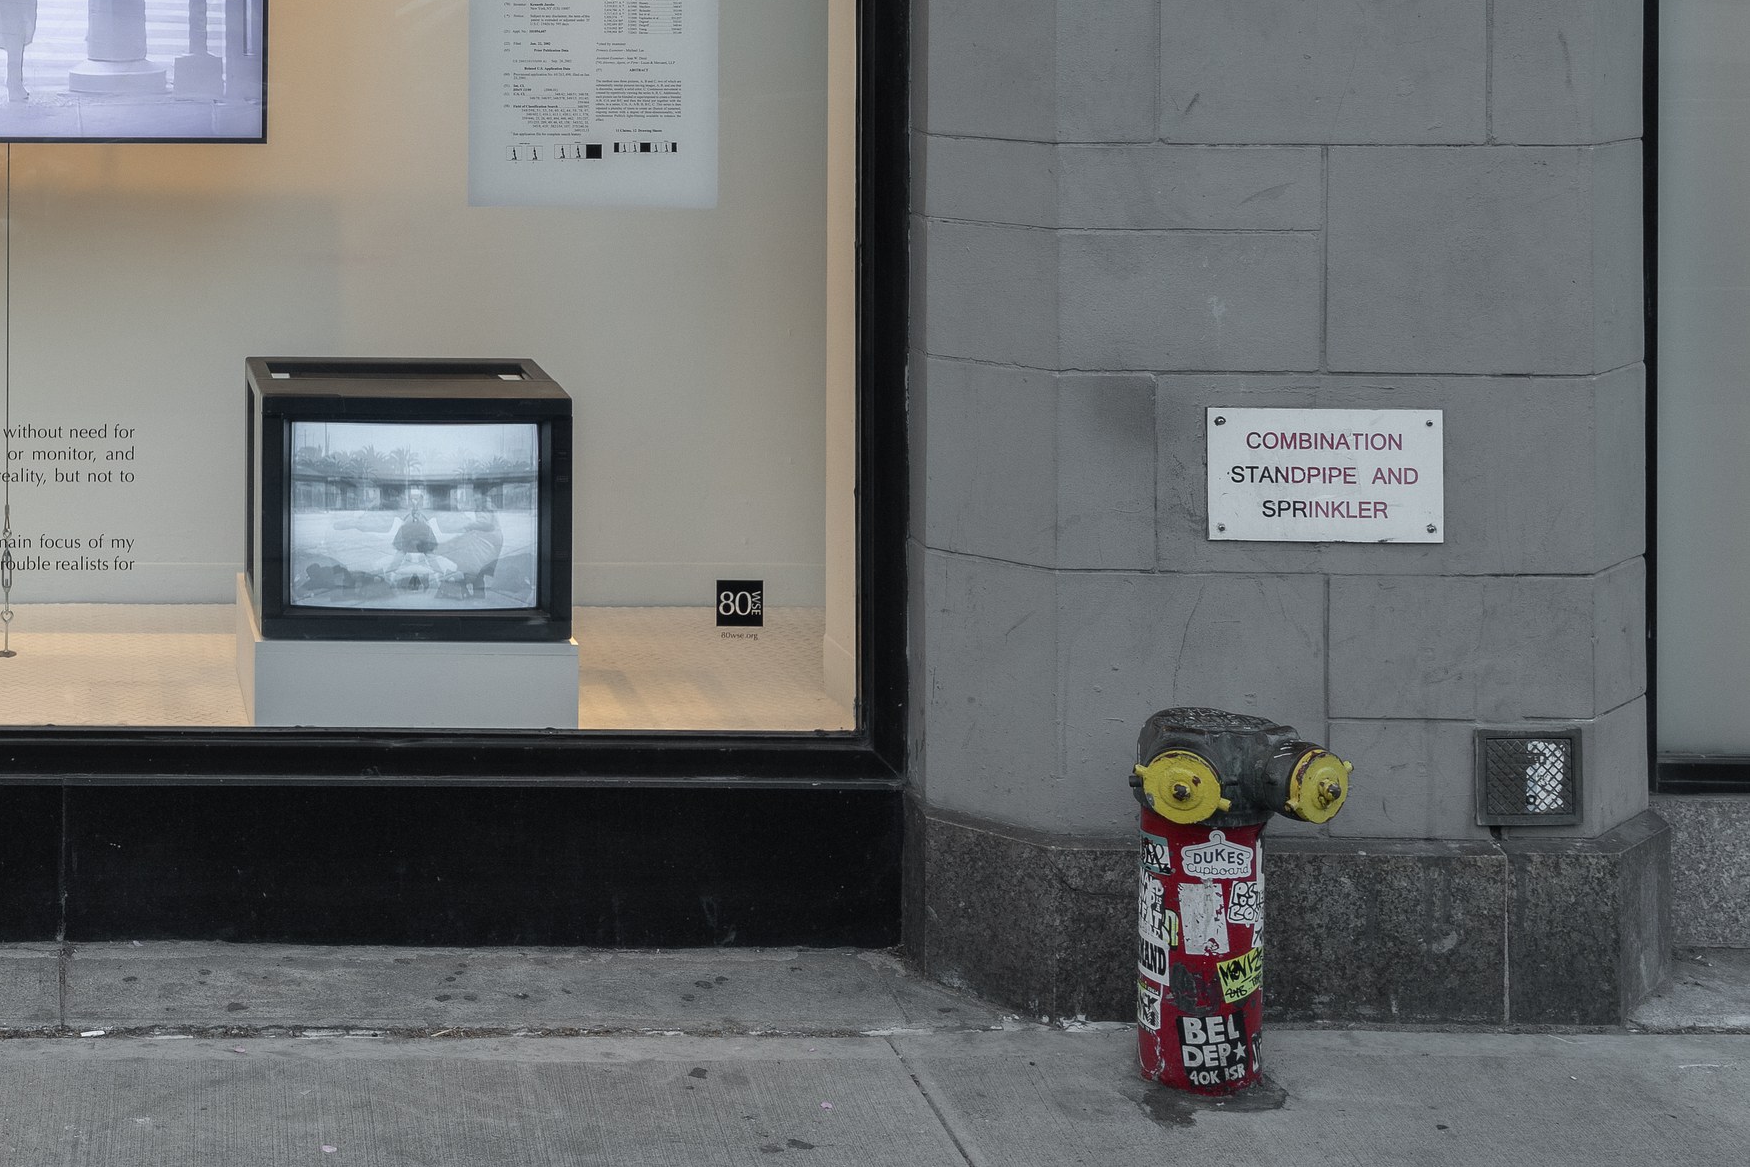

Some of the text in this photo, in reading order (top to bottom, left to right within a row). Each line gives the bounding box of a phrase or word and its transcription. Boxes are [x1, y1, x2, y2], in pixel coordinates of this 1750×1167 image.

[3, 423, 63, 438] without
[70, 424, 107, 438] need
[114, 424, 135, 438] for
[1245, 431, 1403, 451] COMBINATION
[7, 450, 24, 460] or
[33, 447, 96, 463] monitor,
[106, 446, 134, 460] and
[55, 468, 80, 482] but
[88, 471, 112, 482] not
[120, 471, 134, 482] to
[1230, 465, 1419, 485] STANDPIPE AND
[1262, 499, 1389, 519] SPRINKLER
[40, 534, 80, 549] focus
[89, 534, 104, 548] of
[112, 539, 134, 553] my
[56, 556, 108, 570] realists
[114, 556, 135, 570] for
[718, 591, 762, 616] 80 WSE
[720, 632, 759, 641] 80wse.org
[1193, 848, 1244, 866] DUKES
[1186, 863, 1249, 876] Cupboard
[1182, 1014, 1240, 1045] BEL
[1182, 1043, 1232, 1068] DEP
[1189, 1070, 1221, 1085] 40K
